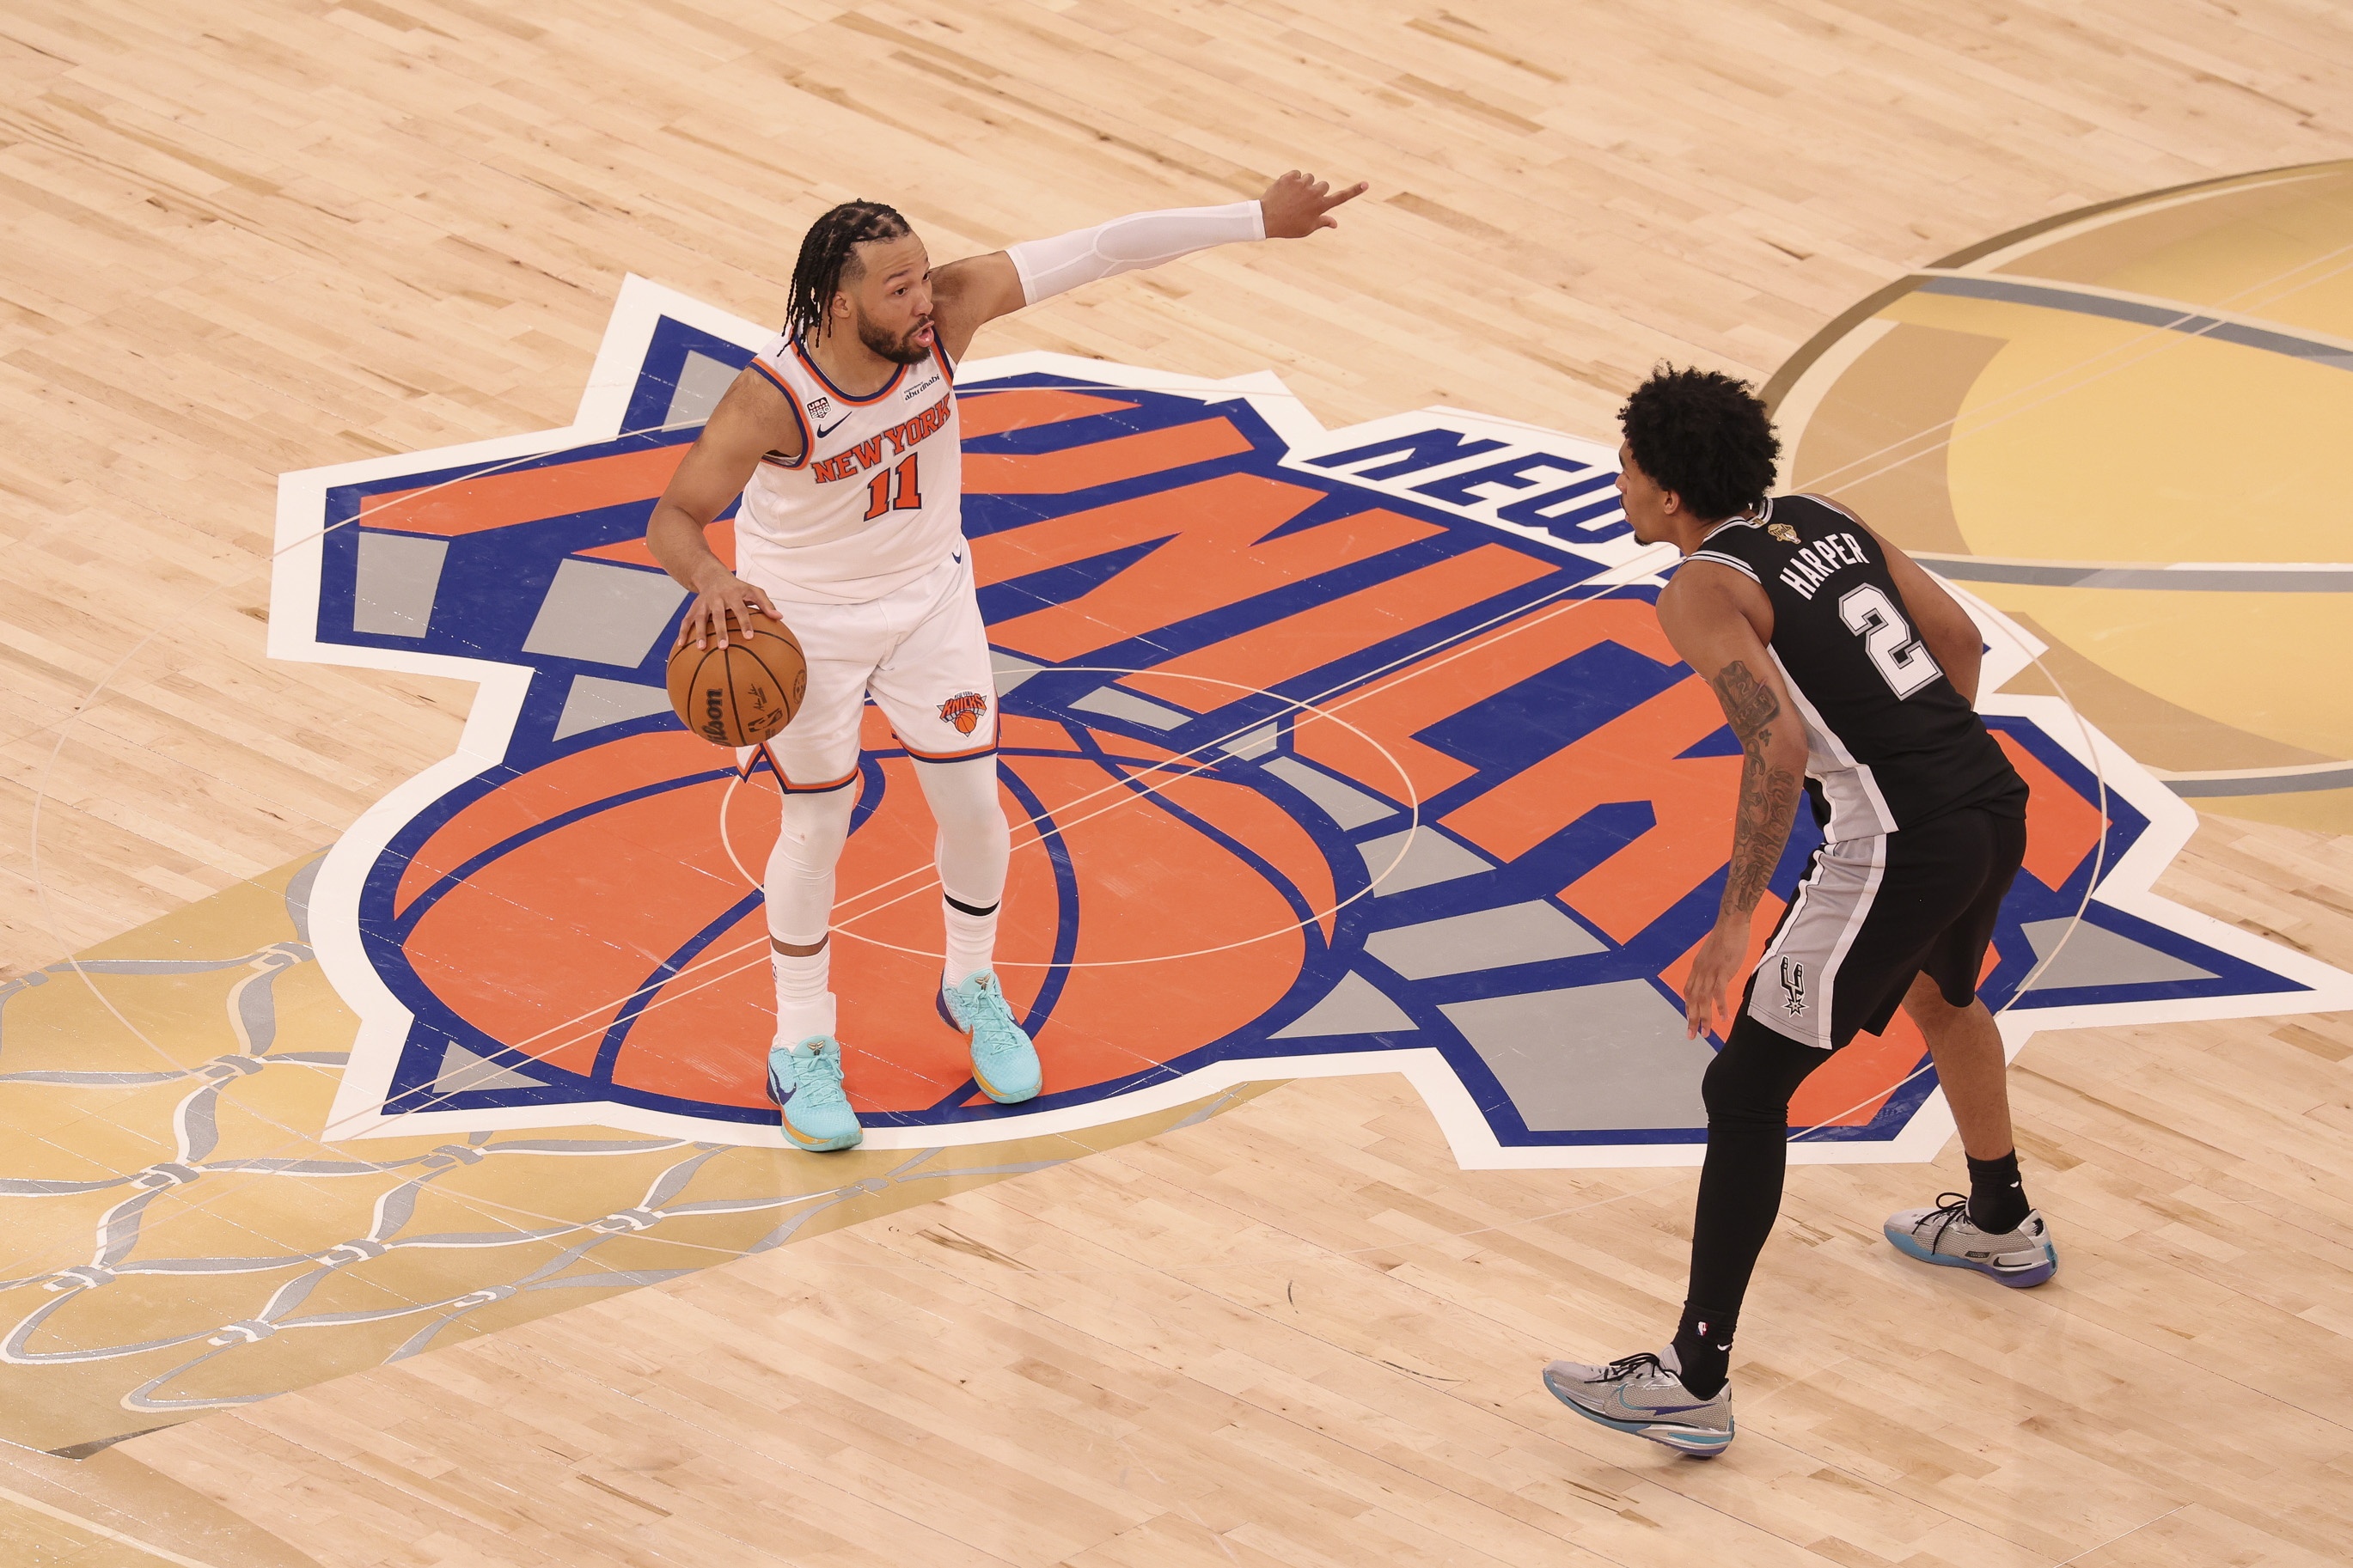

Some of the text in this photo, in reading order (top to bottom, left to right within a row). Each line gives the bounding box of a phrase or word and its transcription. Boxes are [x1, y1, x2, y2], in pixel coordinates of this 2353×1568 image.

[808, 399, 827, 410] USA
[905, 374, 940, 400] abu dhabi
[810, 393, 951, 484] NEW YORK
[863, 452, 922, 522] 11
[1779, 533, 1870, 601] HARPER
[1838, 583, 1944, 701] 2
[939, 693, 987, 719] KNICKS
